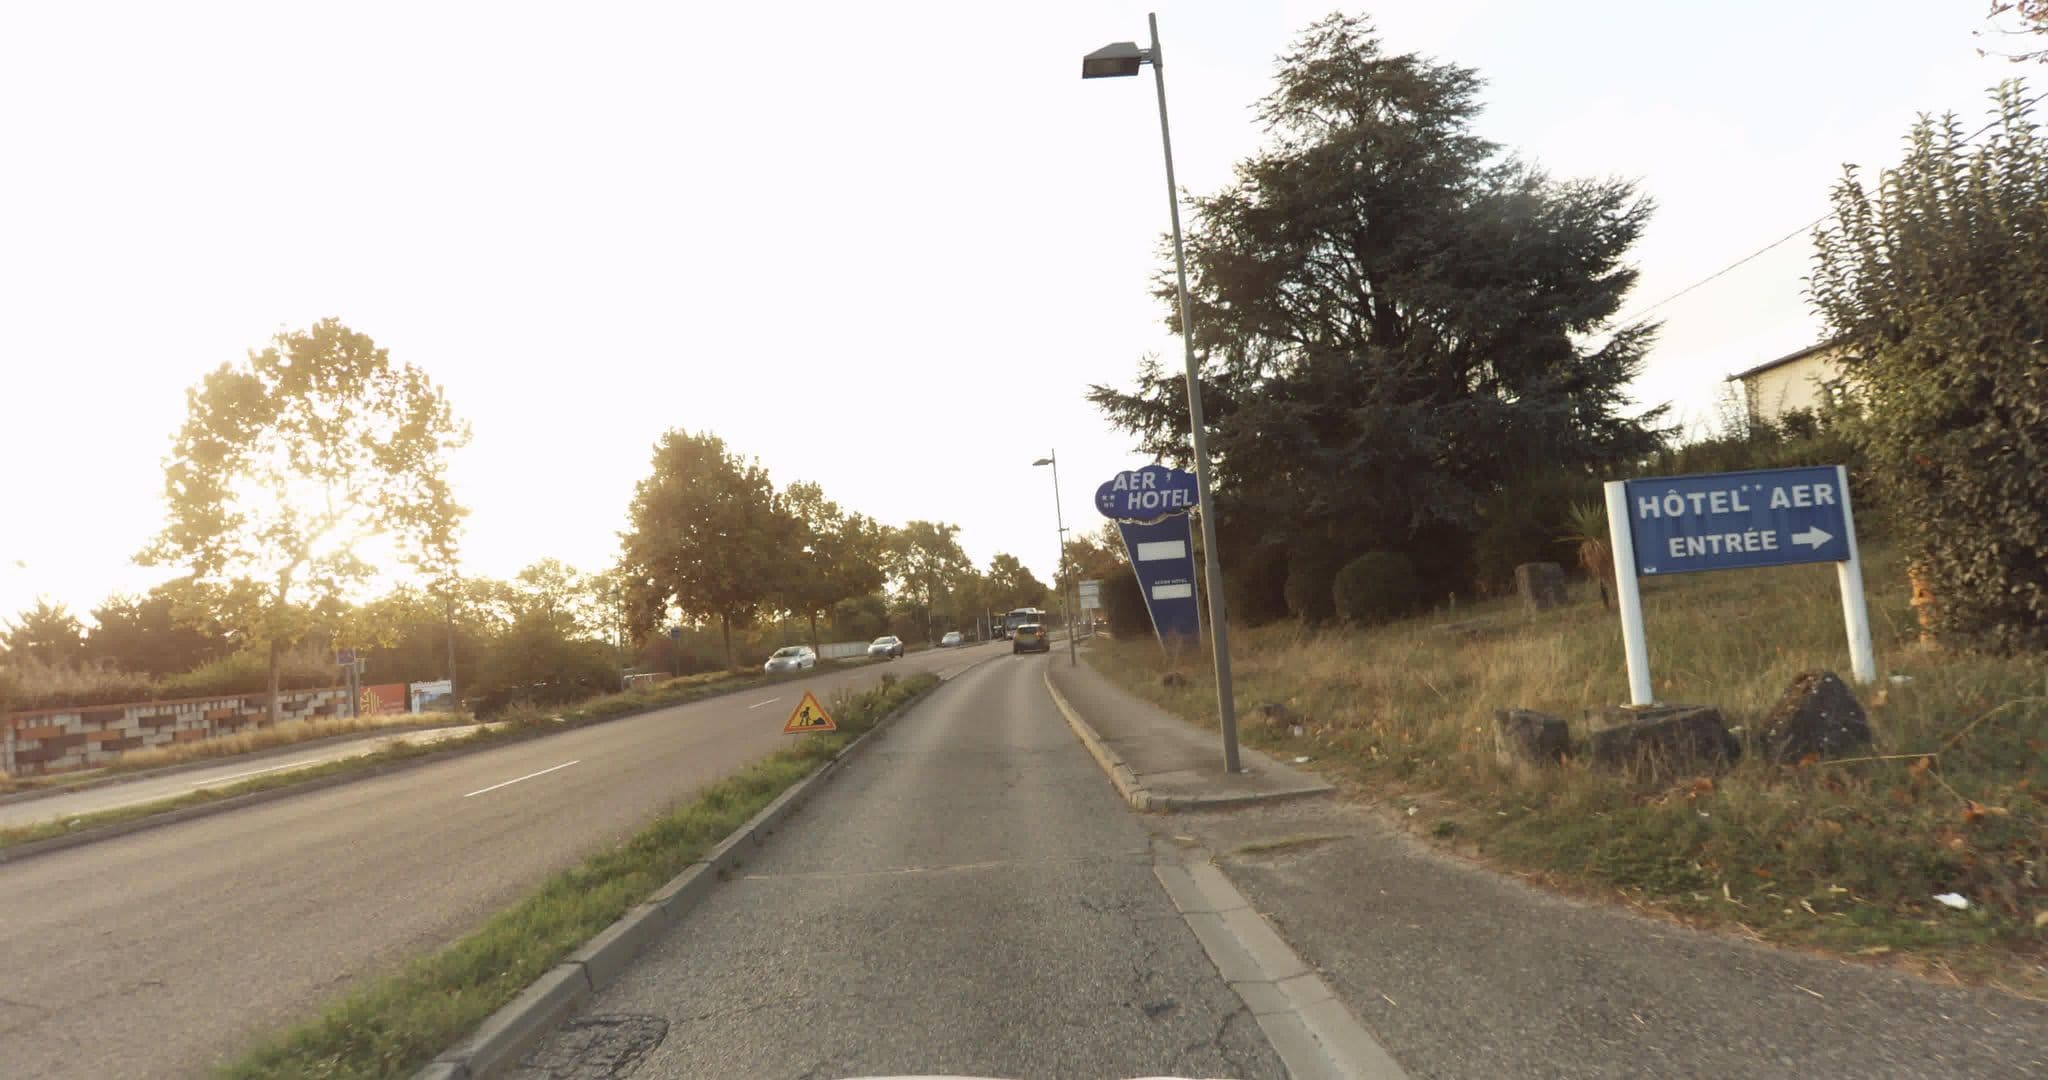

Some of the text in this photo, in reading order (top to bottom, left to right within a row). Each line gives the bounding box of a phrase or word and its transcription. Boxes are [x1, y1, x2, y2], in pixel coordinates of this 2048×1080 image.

[1113, 472, 1156, 491] AER
[1128, 489, 1192, 510] HOTEL
[1639, 484, 1834, 519] HÔTEL AER
[1669, 528, 1778, 557] ENTRÉE
